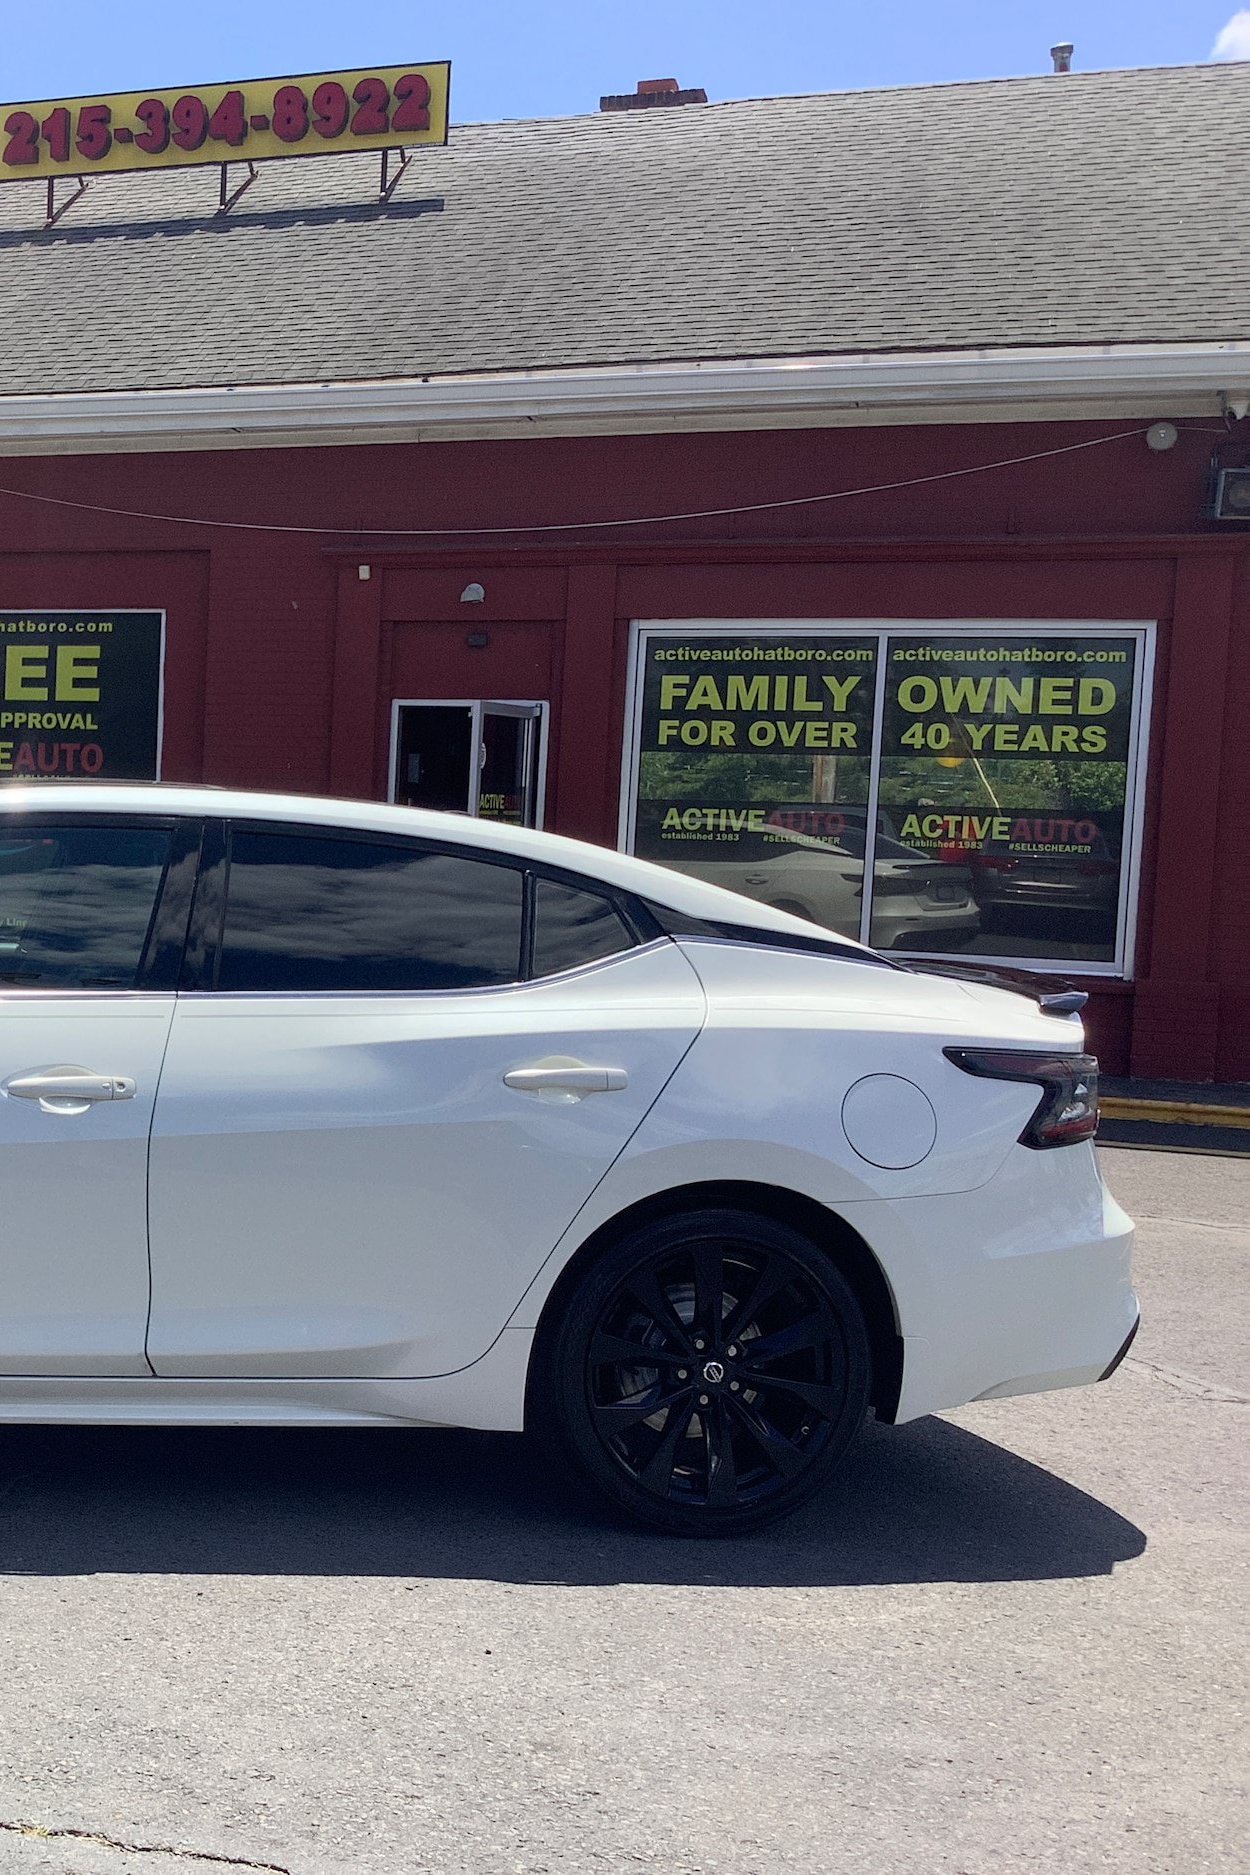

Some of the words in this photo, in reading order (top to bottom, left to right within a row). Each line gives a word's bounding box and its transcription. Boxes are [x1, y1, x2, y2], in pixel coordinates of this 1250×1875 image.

[2, 73, 430, 166] 215-394-8922
[654, 647, 873, 661] activeautohatboro.com
[893, 647, 1126, 662] activeautohatboro.com
[660, 674, 862, 712] FAMILY
[898, 676, 1116, 715] OWNED
[658, 719, 736, 747] FOR
[748, 720, 857, 748] OVER
[901, 722, 950, 749] 40
[964, 724, 1107, 753] YEARS
[661, 832, 713, 841] established
[715, 833, 739, 841] 1983
[763, 834, 840, 844] #SELLSCHEAPER
[900, 839, 955, 849] established
[958, 840, 983, 849] 1983
[1009, 843, 1092, 853] #SELLSCHEAPER
